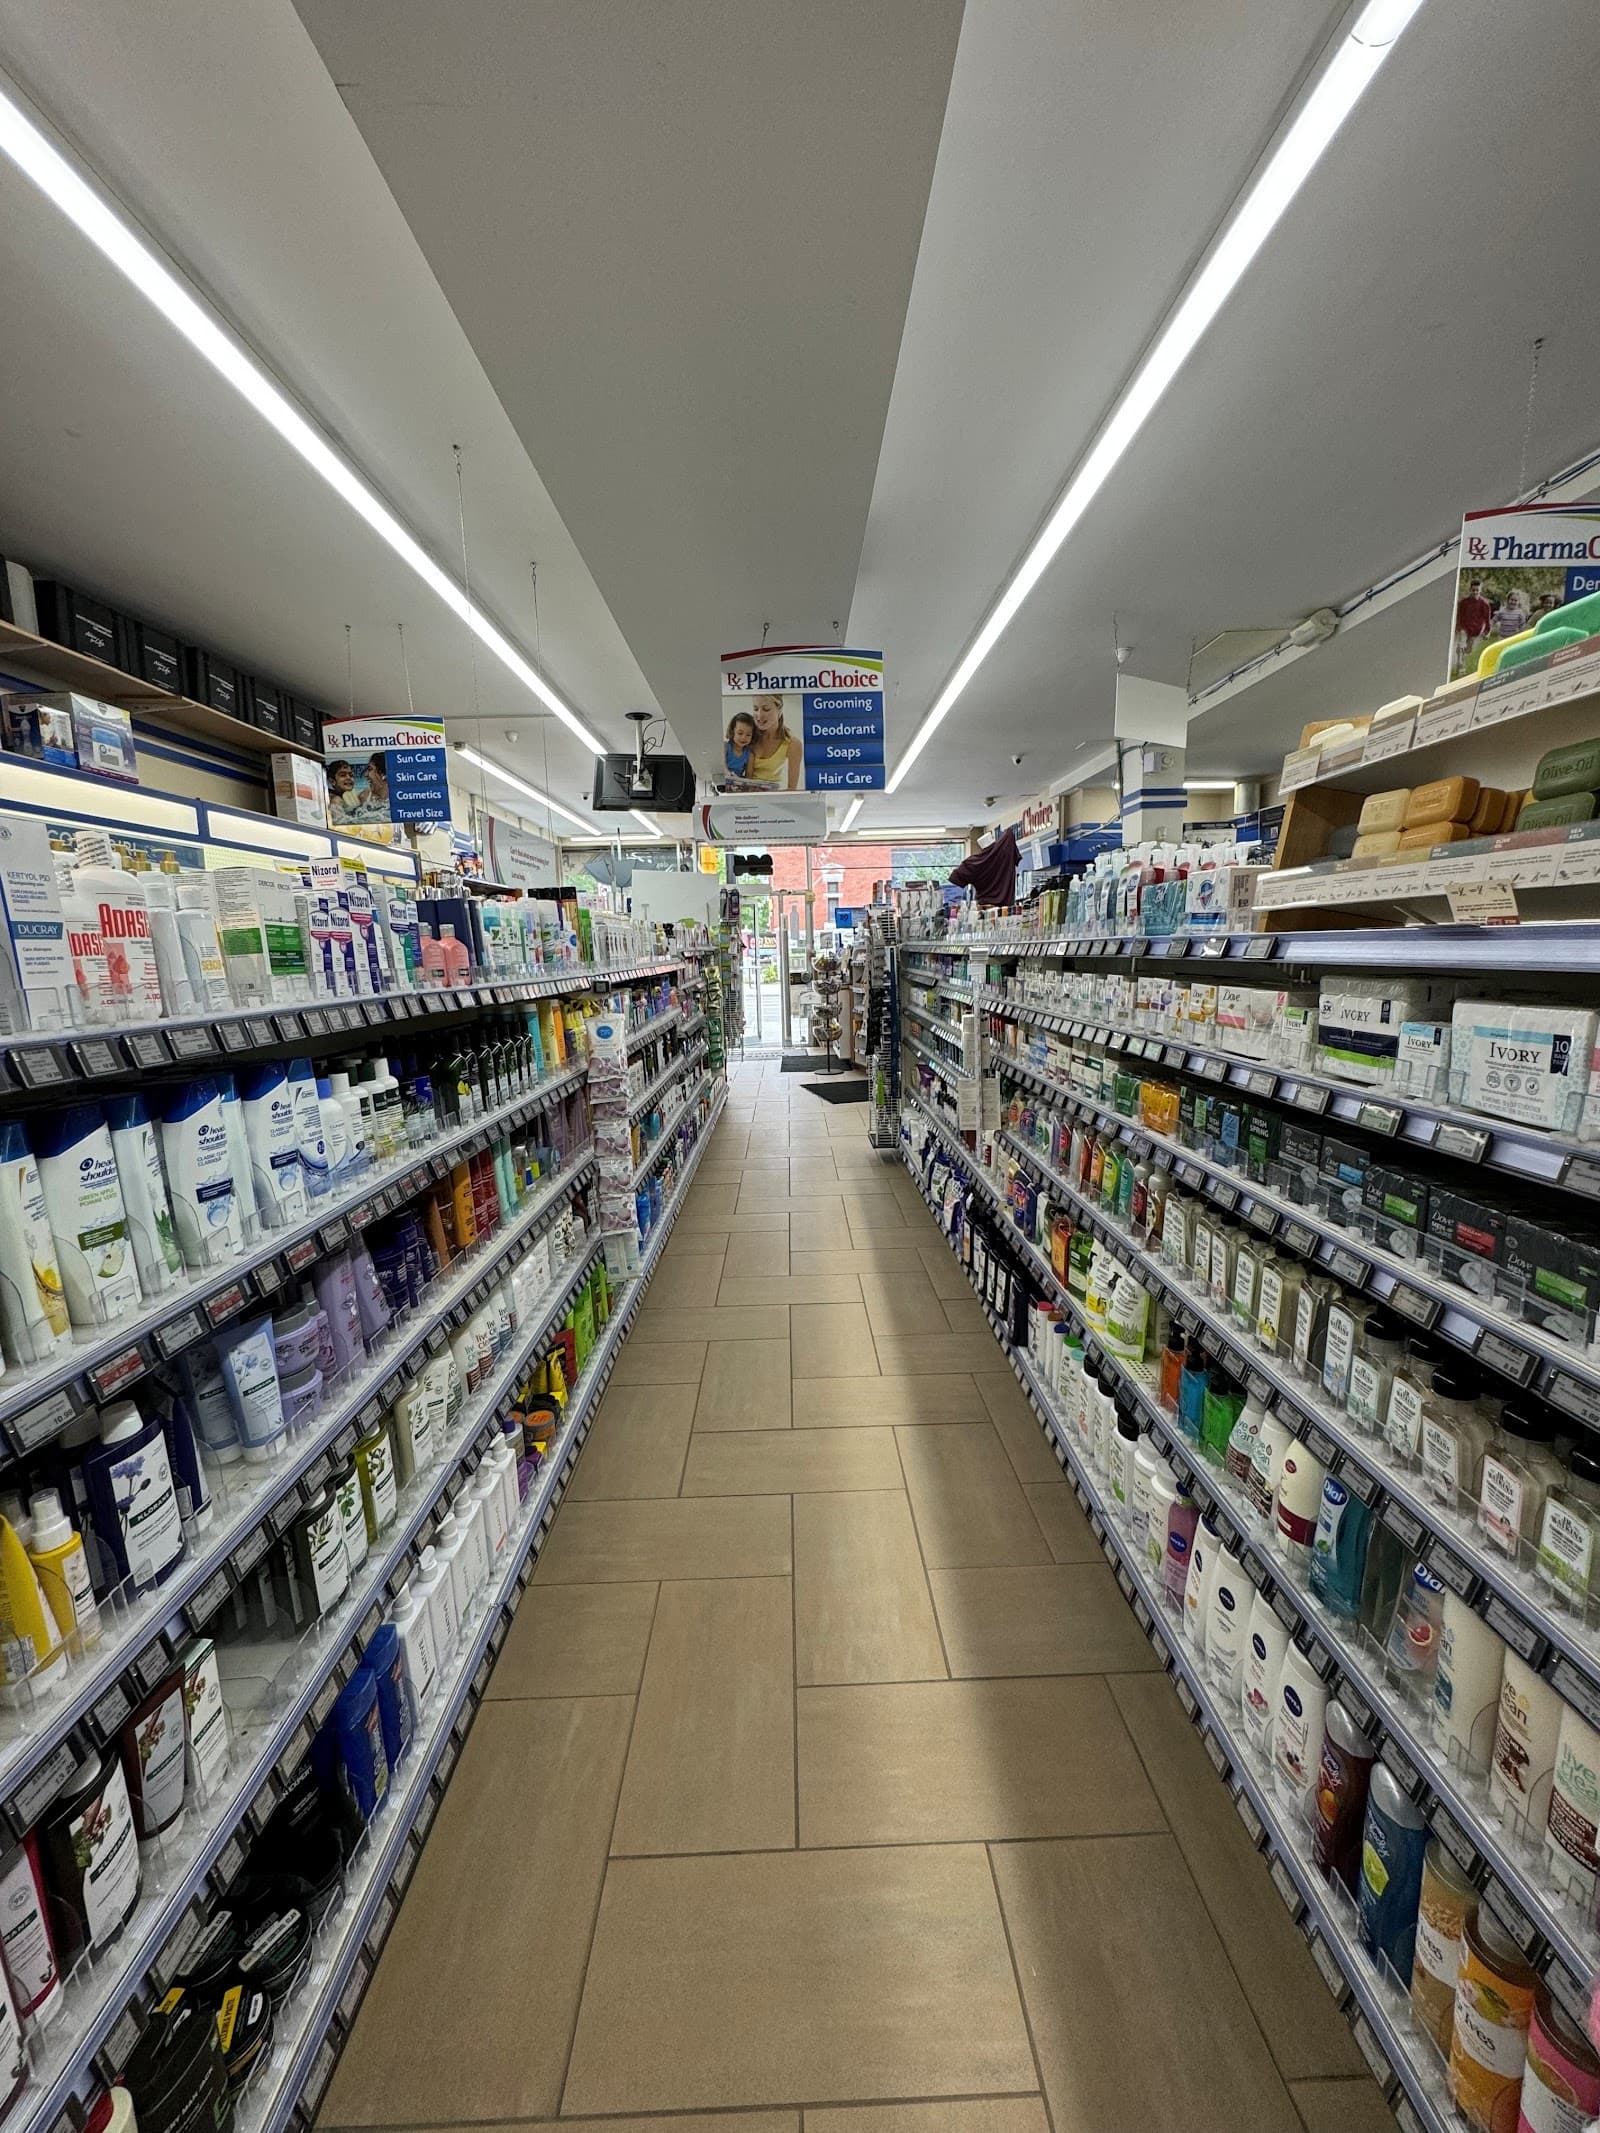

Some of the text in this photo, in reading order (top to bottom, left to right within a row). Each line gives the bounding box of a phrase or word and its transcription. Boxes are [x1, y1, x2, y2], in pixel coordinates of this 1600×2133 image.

[746, 669, 878, 690] PharmaChoice
[813, 697, 873, 712] Grooming
[811, 723, 876, 737] Deodorant
[342, 731, 442, 748] PharmaChoice
[396, 753, 436, 764] Sun Care
[826, 746, 861, 761] Soaps
[396, 772, 438, 782] Skin Care
[818, 772, 873, 785] Hair Care
[396, 790, 442, 801] Cosmetics
[397, 808, 444, 819] Travel Size
[312, 863, 339, 877] Nizoral
[348, 890, 370, 908] Nizoral
[311, 915, 329, 928] Nizoral
[330, 912, 350, 928] Nizoral
[17, 923, 58, 936] DUCRAY
[1222, 991, 1241, 1001] Dove
[1340, 1008, 1371, 1022] IVORY
[1407, 1036, 1433, 1049] IVORY
[1554, 1041, 1569, 1053] 10
[1489, 1042, 1541, 1064] IVORY
[1252, 1117, 1268, 1129] IRISH
[1250, 1124, 1270, 1138] SPRING
[1431, 1209, 1455, 1226] Dove
[1508, 1253, 1533, 1270] Dove
[1324, 1479, 1346, 1502] Dial
[137, 1488, 172, 1522] KLORANE
